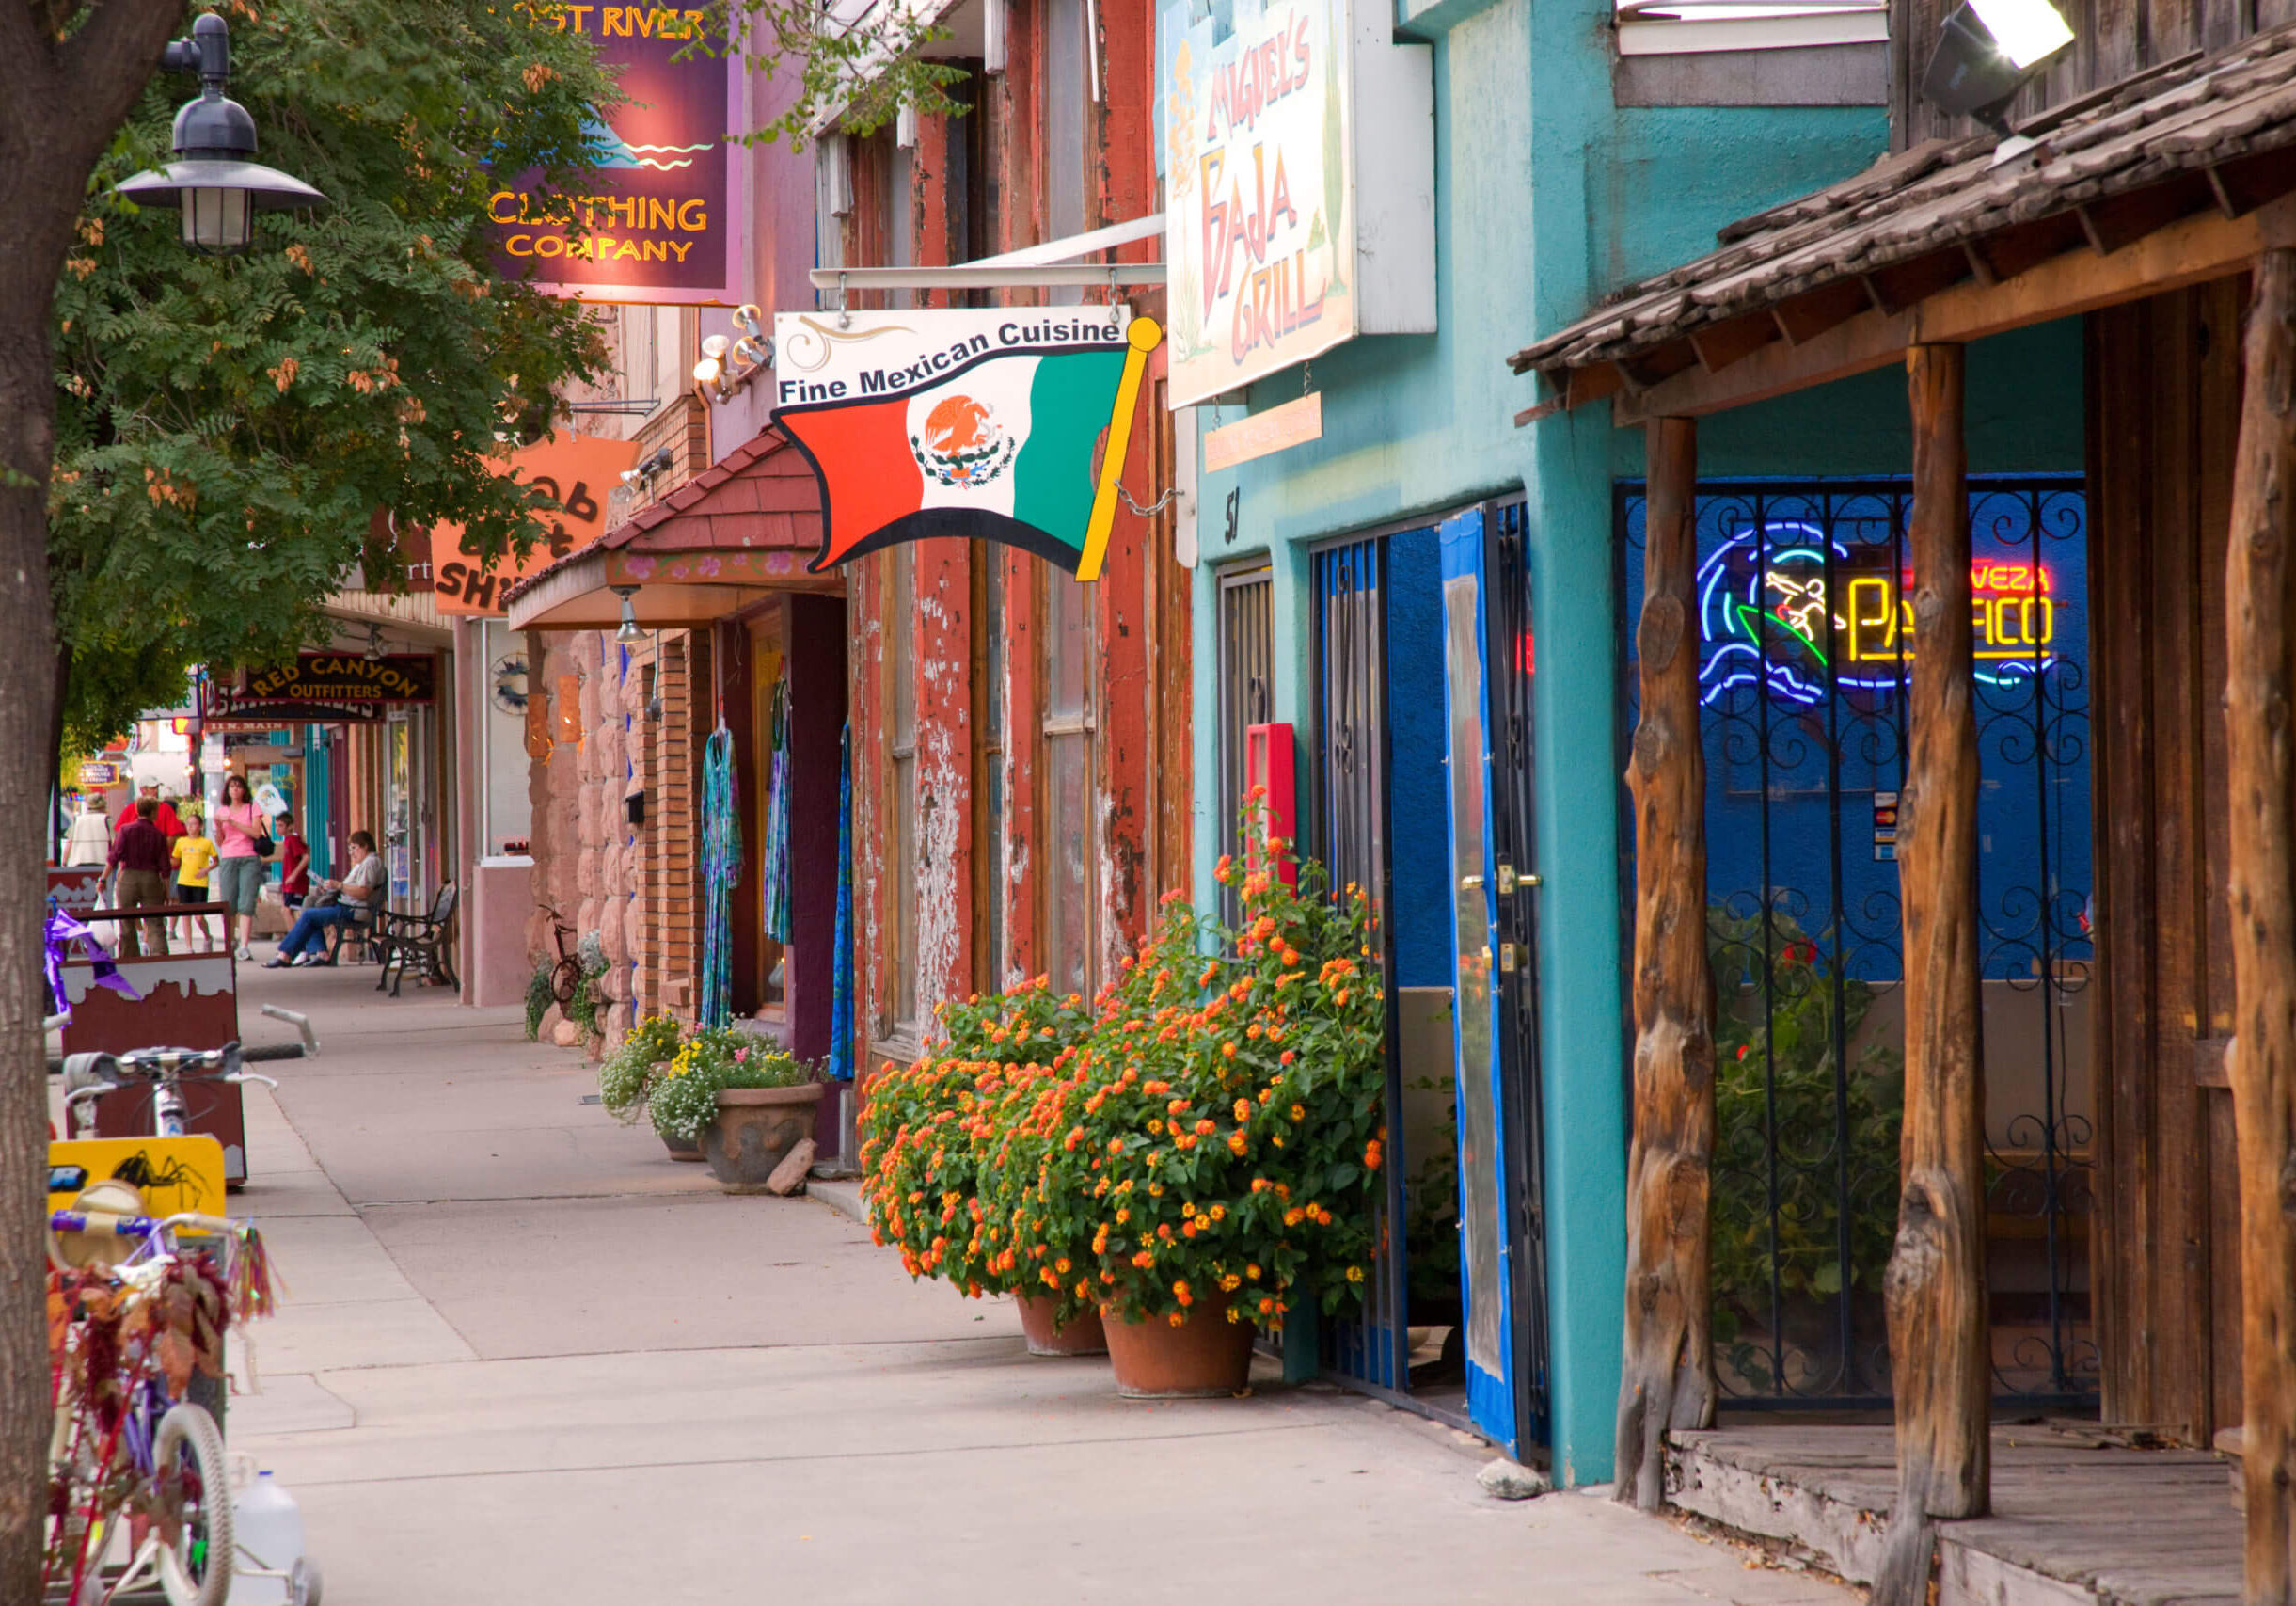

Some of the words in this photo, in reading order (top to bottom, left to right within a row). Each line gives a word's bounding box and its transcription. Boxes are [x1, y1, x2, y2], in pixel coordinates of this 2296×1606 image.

[602, 6, 705, 40] RIVER
[1207, 8, 1311, 142] MIGUEL'S
[487, 191, 706, 231] CLOTHING
[1200, 142, 1297, 329] BAJA
[505, 234, 694, 262] COMPANY
[1231, 248, 1327, 366] GRILL
[779, 379, 847, 403] Fine
[859, 333, 989, 394] Mexican
[998, 318, 1120, 346] Cuisine
[1225, 485, 1240, 545] 51
[1849, 578, 2053, 661] PAICO
[252, 665, 300, 697] RED
[310, 657, 419, 698] CANYON
[289, 684, 382, 699] OUTFITTERS
